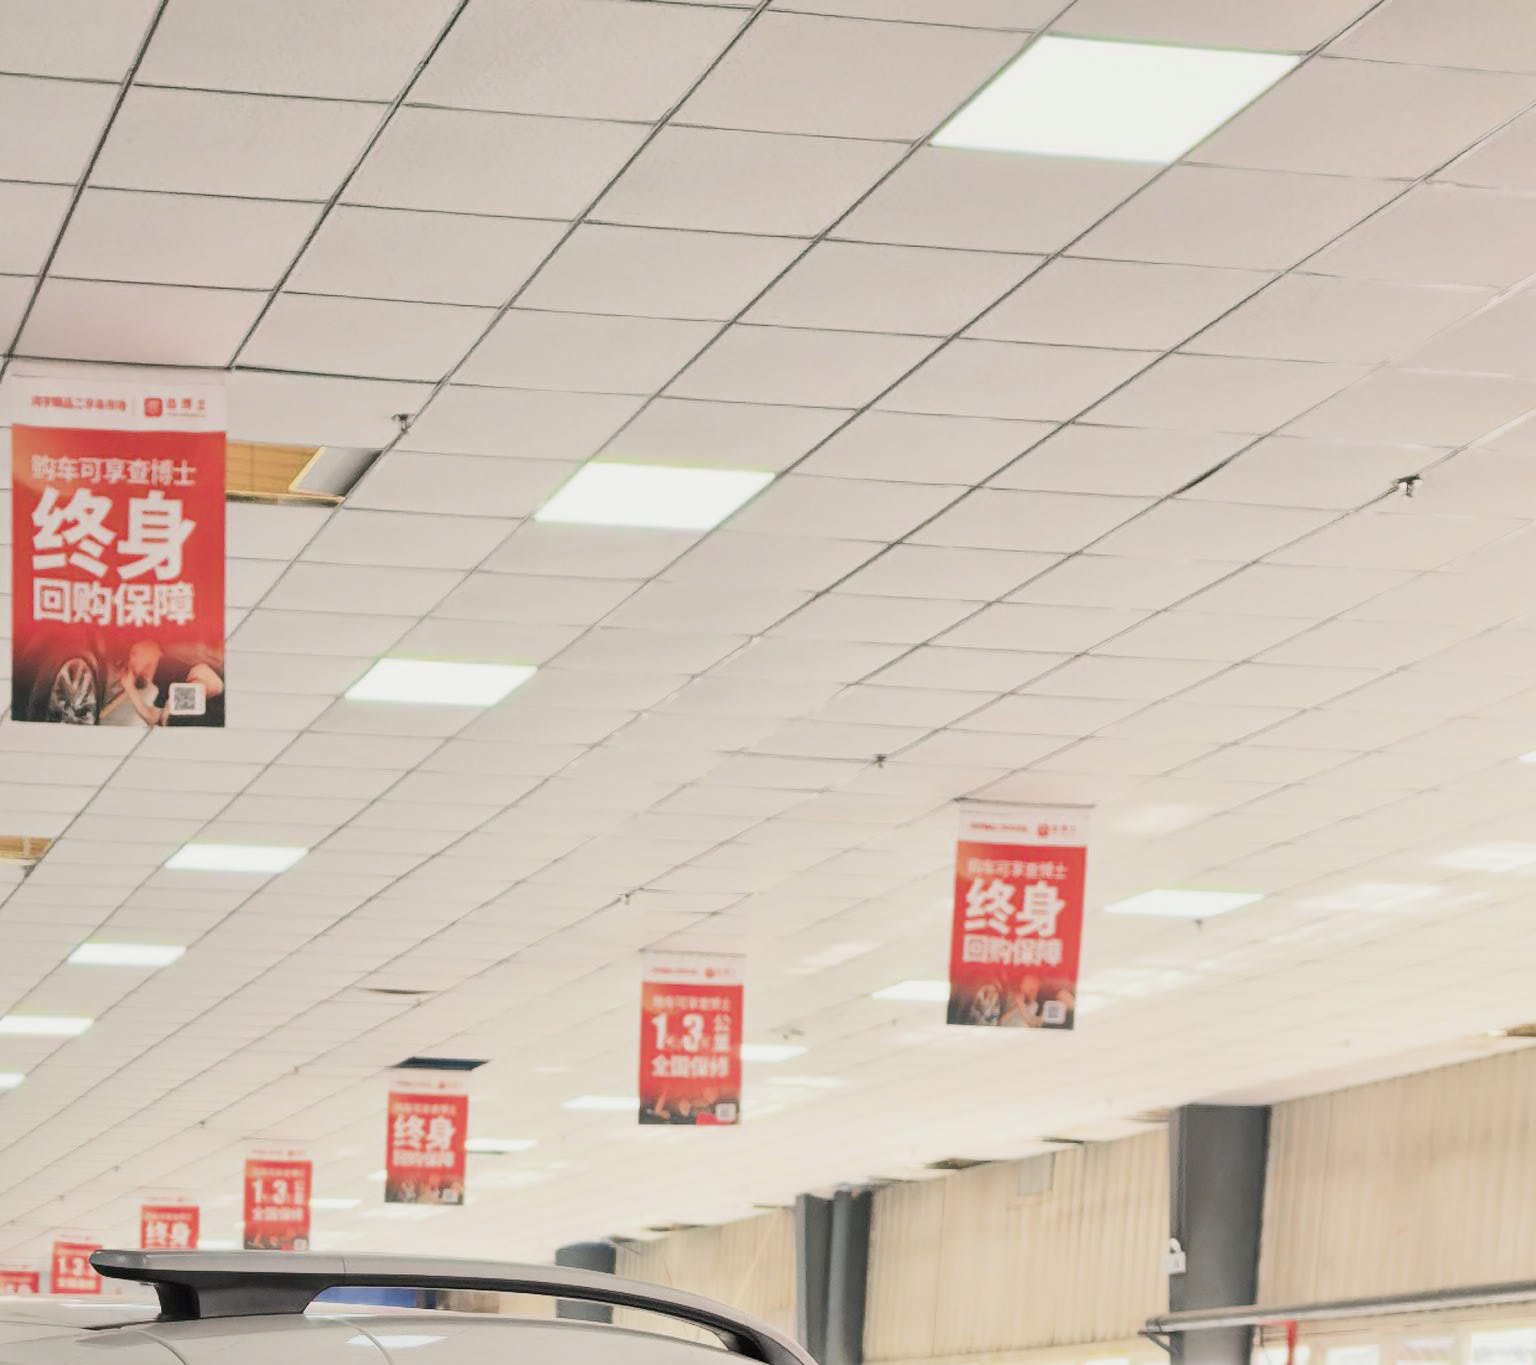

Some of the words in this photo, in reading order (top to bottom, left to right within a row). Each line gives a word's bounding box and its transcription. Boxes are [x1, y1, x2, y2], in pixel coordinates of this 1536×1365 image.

[31, 455, 197, 487] 购车可享查博士
[31, 487, 197, 581] 终身
[32, 577, 196, 627] 回购保障
[964, 878, 1066, 938] 终身
[392, 1113, 456, 1151] 终身
